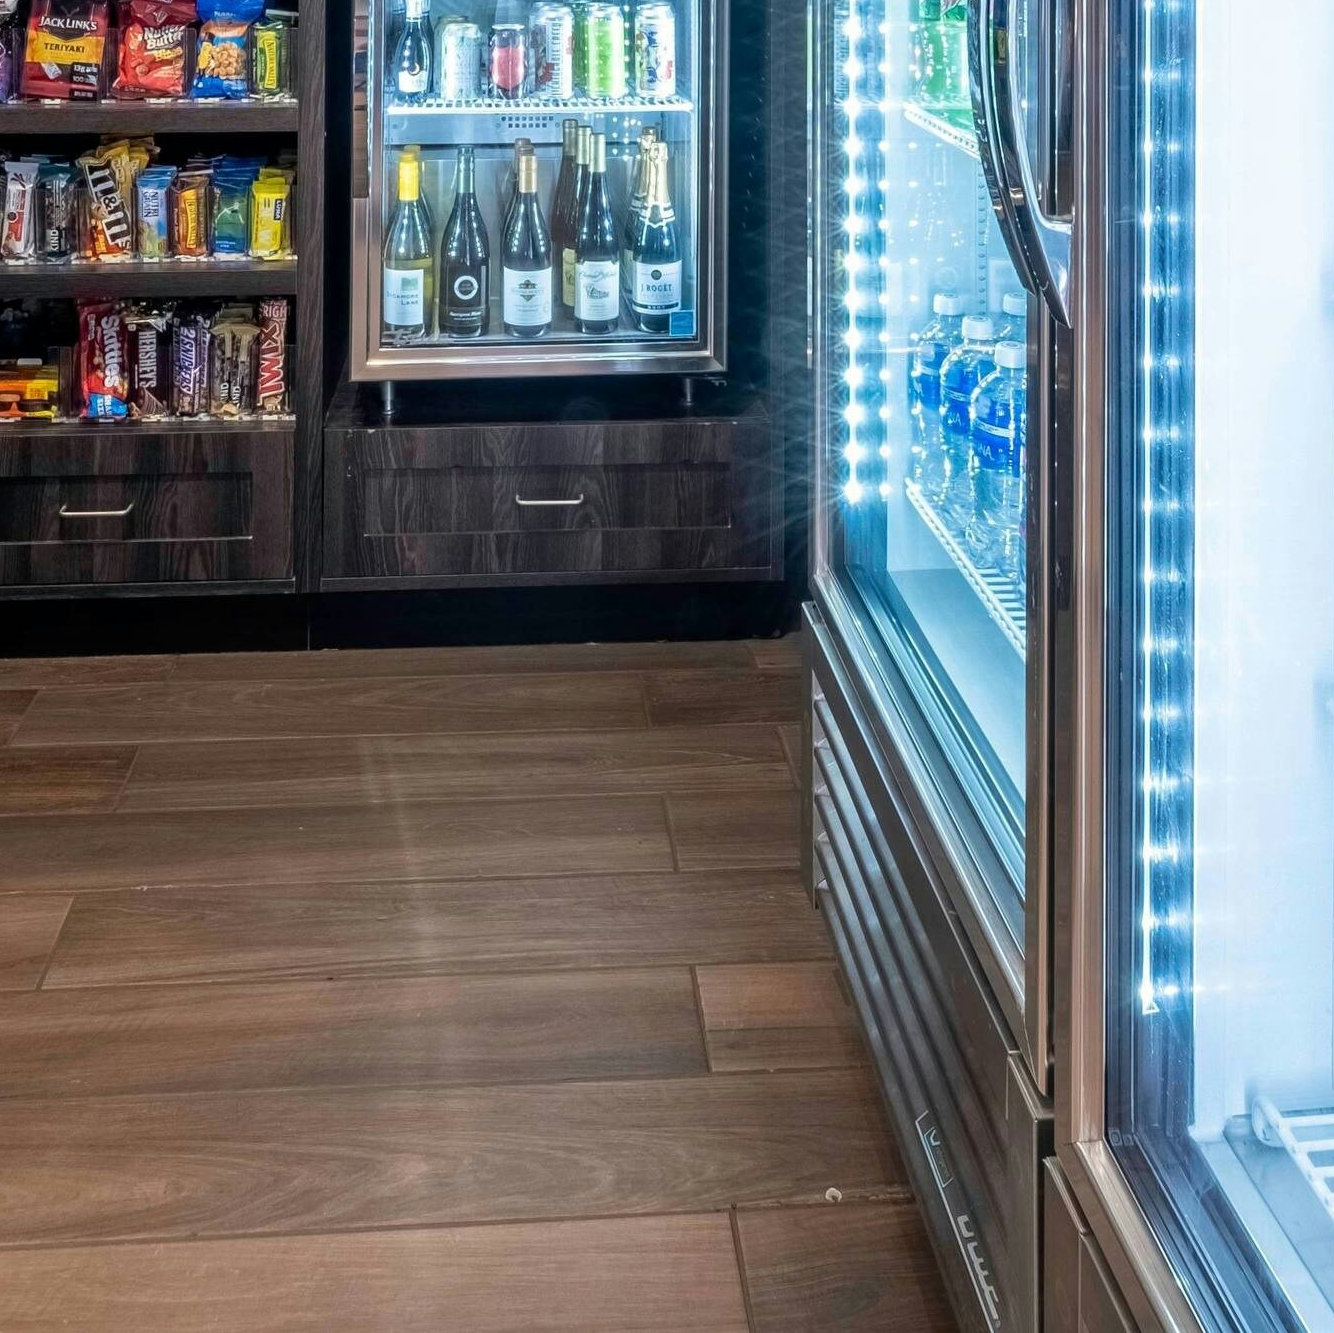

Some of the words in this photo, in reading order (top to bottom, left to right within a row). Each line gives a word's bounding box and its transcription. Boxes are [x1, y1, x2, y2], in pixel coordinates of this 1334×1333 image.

[39, 16, 64, 29] JACK
[44, 42, 85, 54] TERIYAKI
[275, 200, 283, 221] LUNA
[50, 229, 59, 251] KIND
[258, 320, 286, 401] TWIX
